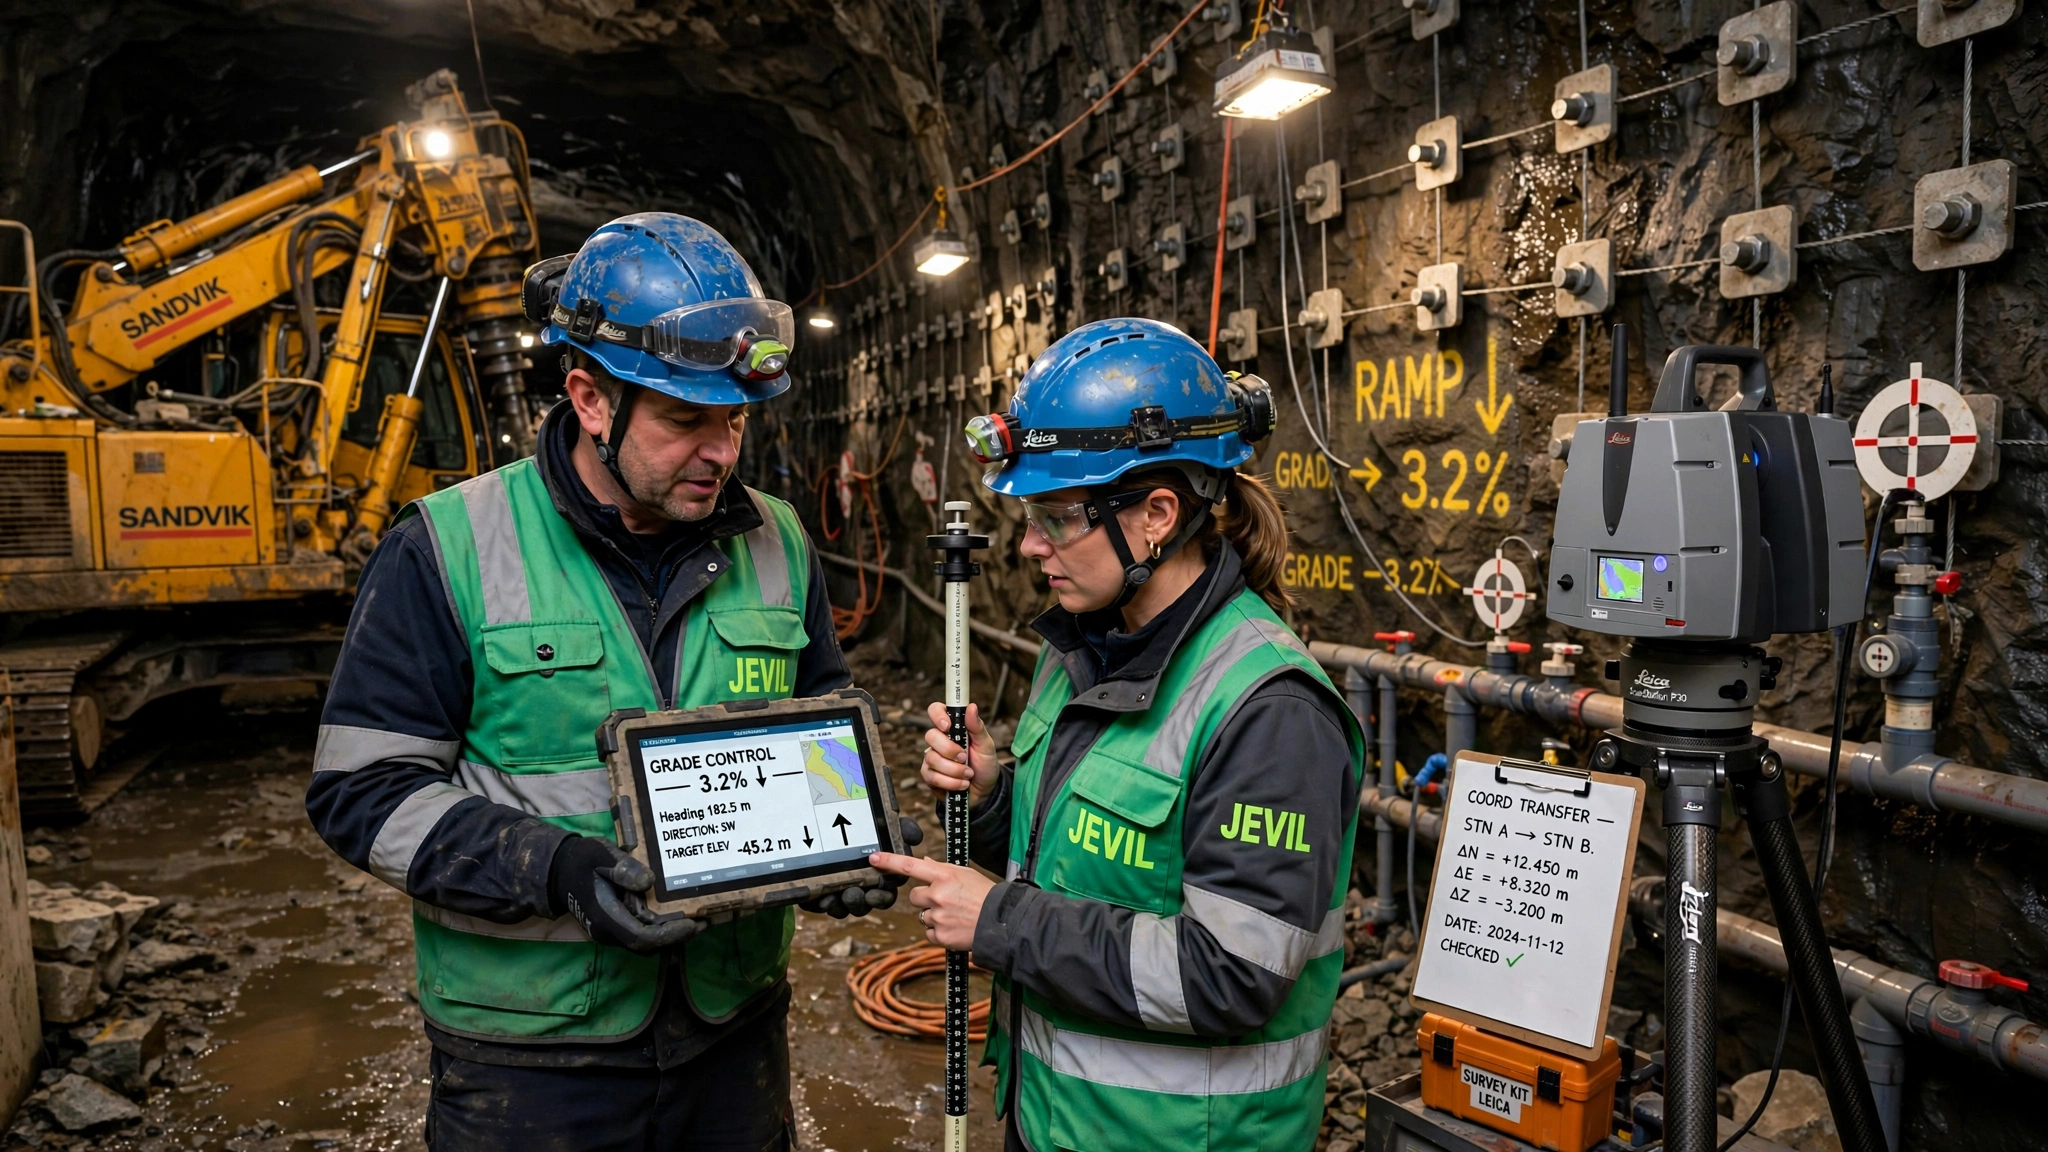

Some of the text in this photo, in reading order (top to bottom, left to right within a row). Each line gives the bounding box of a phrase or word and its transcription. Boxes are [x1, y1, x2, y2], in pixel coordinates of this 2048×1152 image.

[121, 276, 228, 339] SANDVIK
[1356, 350, 1464, 422] RAMP
[1022, 429, 1058, 448] Leica
[1275, 449, 1511, 517] GRAD 3.2%
[119, 505, 251, 528] SANDVIK
[1282, 552, 1354, 590] GRADE
[728, 657, 789, 693] JEVIL
[1634, 669, 1671, 689] Leica
[1671, 692, 1687, 702] P30
[650, 747, 776, 773] GRADE CONTROL
[699, 771, 748, 793] 3.2%
[659, 802, 752, 823] Heading 182.5 m
[1467, 790, 1590, 824] COORD TRANSFER
[721, 821, 736, 832] SW
[1068, 808, 1155, 869] JEVIL
[1221, 803, 1310, 852] JEVIL
[1463, 817, 1594, 855] STN A STN B.
[665, 838, 792, 860] TARGET ELEV -45.2 m
[1457, 844, 1479, 860] ΔN
[1502, 854, 1561, 876] +12.450
[1566, 867, 1579, 880] m
[1454, 866, 1474, 881] ΔE
[1499, 876, 1551, 897] +8.320
[1556, 888, 1569, 901] m
[1450, 887, 1470, 903] ΔZ
[1495, 898, 1546, 920] -3.200
[1551, 911, 1564, 925] m
[1440, 938, 1500, 964] CHECKED
[1444, 913, 1564, 955] DATE: 2024-11-12
[1464, 1069, 1529, 1102] SURVEY KIT
[1479, 1091, 1511, 1115] LEICA
